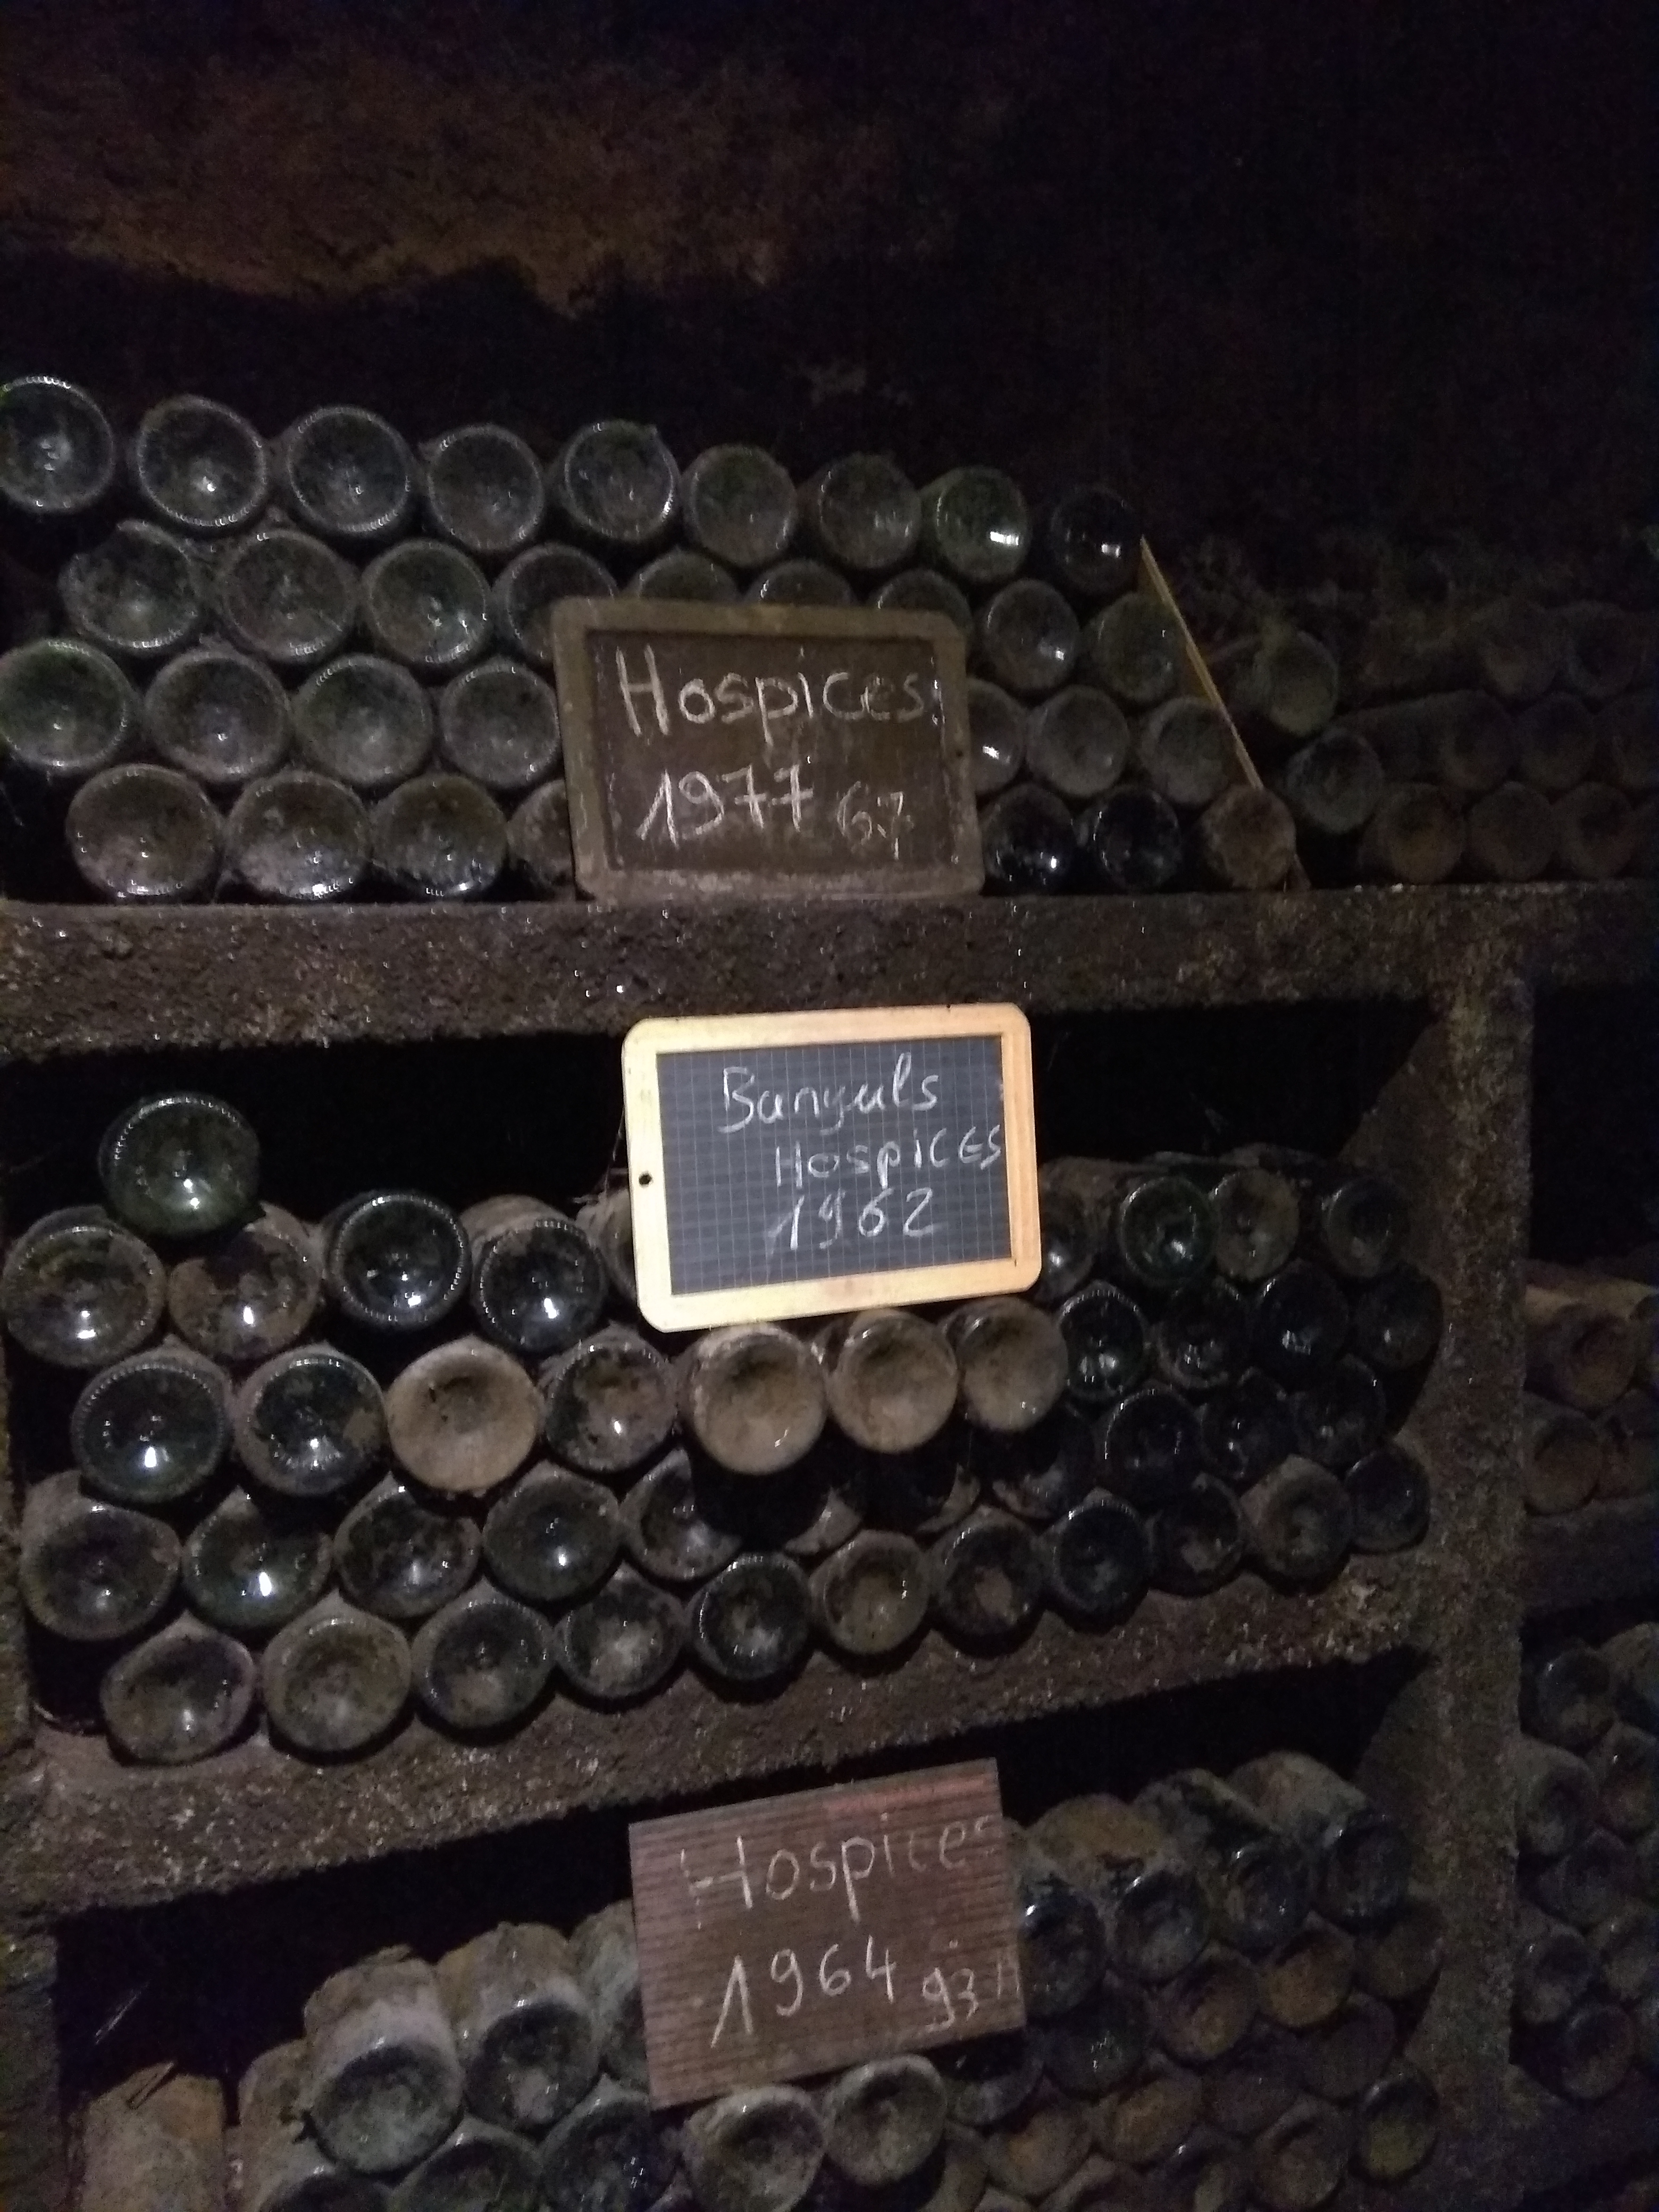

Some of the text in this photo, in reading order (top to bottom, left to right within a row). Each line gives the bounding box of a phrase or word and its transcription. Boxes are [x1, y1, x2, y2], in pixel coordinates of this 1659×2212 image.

[615, 645, 924, 746] Hospices
[637, 764, 814, 847] 1977
[718, 1051, 940, 1135] Banyuls
[767, 1185, 937, 1251] 1962
[710, 1935, 898, 2049] 1964
